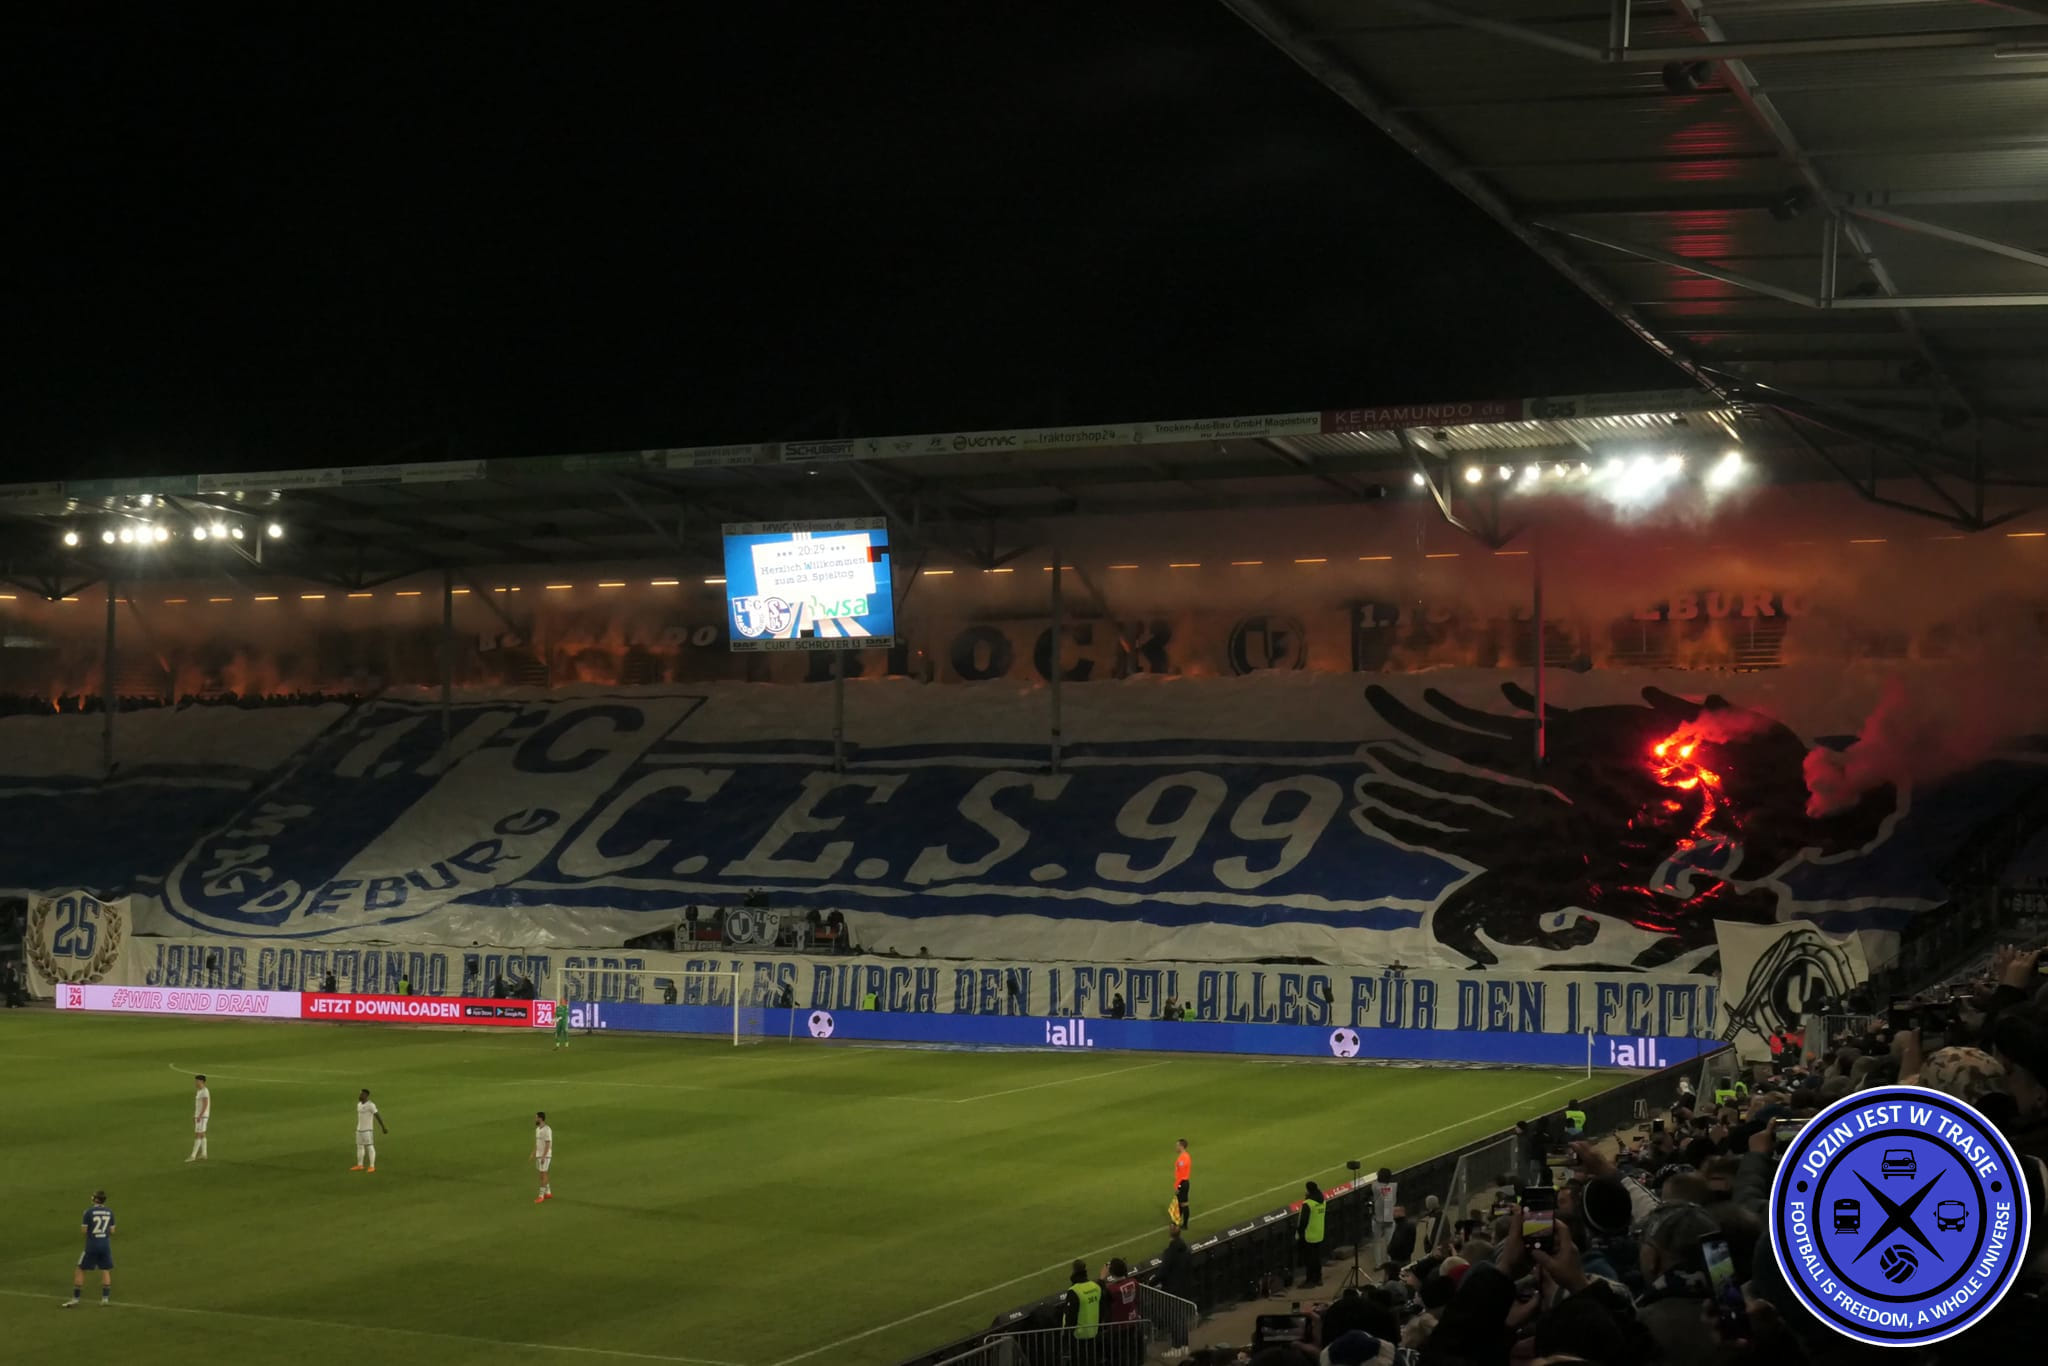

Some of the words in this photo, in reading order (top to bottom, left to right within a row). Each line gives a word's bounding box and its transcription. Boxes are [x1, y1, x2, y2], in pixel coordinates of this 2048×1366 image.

[760, 562, 802, 576] Herzlich
[803, 556, 866, 571] Willkommen
[775, 575, 796, 586] zum
[764, 640, 791, 650] CURT
[52, 895, 99, 961] 25
[146, 943, 248, 990] JAHRE
[257, 946, 450, 997] COMMANDO
[564, 956, 646, 1002] SIDE
[684, 958, 799, 1008] ALLES
[810, 963, 939, 1013] DURCH
[953, 966, 1033, 1017] DEN
[1196, 969, 1336, 1027] ALLES
[1350, 969, 1438, 1031] FÜR
[1457, 978, 1548, 1034] DEN
[69, 994, 82, 1006] 24
[112, 988, 162, 1009] #WIR
[167, 992, 210, 1012] SIND
[216, 993, 270, 1013] DRAN
[310, 998, 352, 1015] JETZT
[355, 999, 461, 1018] DOWNLOADEN
[537, 1011, 553, 1024] 24
[568, 1003, 607, 1028] all.
[92, 1215, 111, 1234] 27
